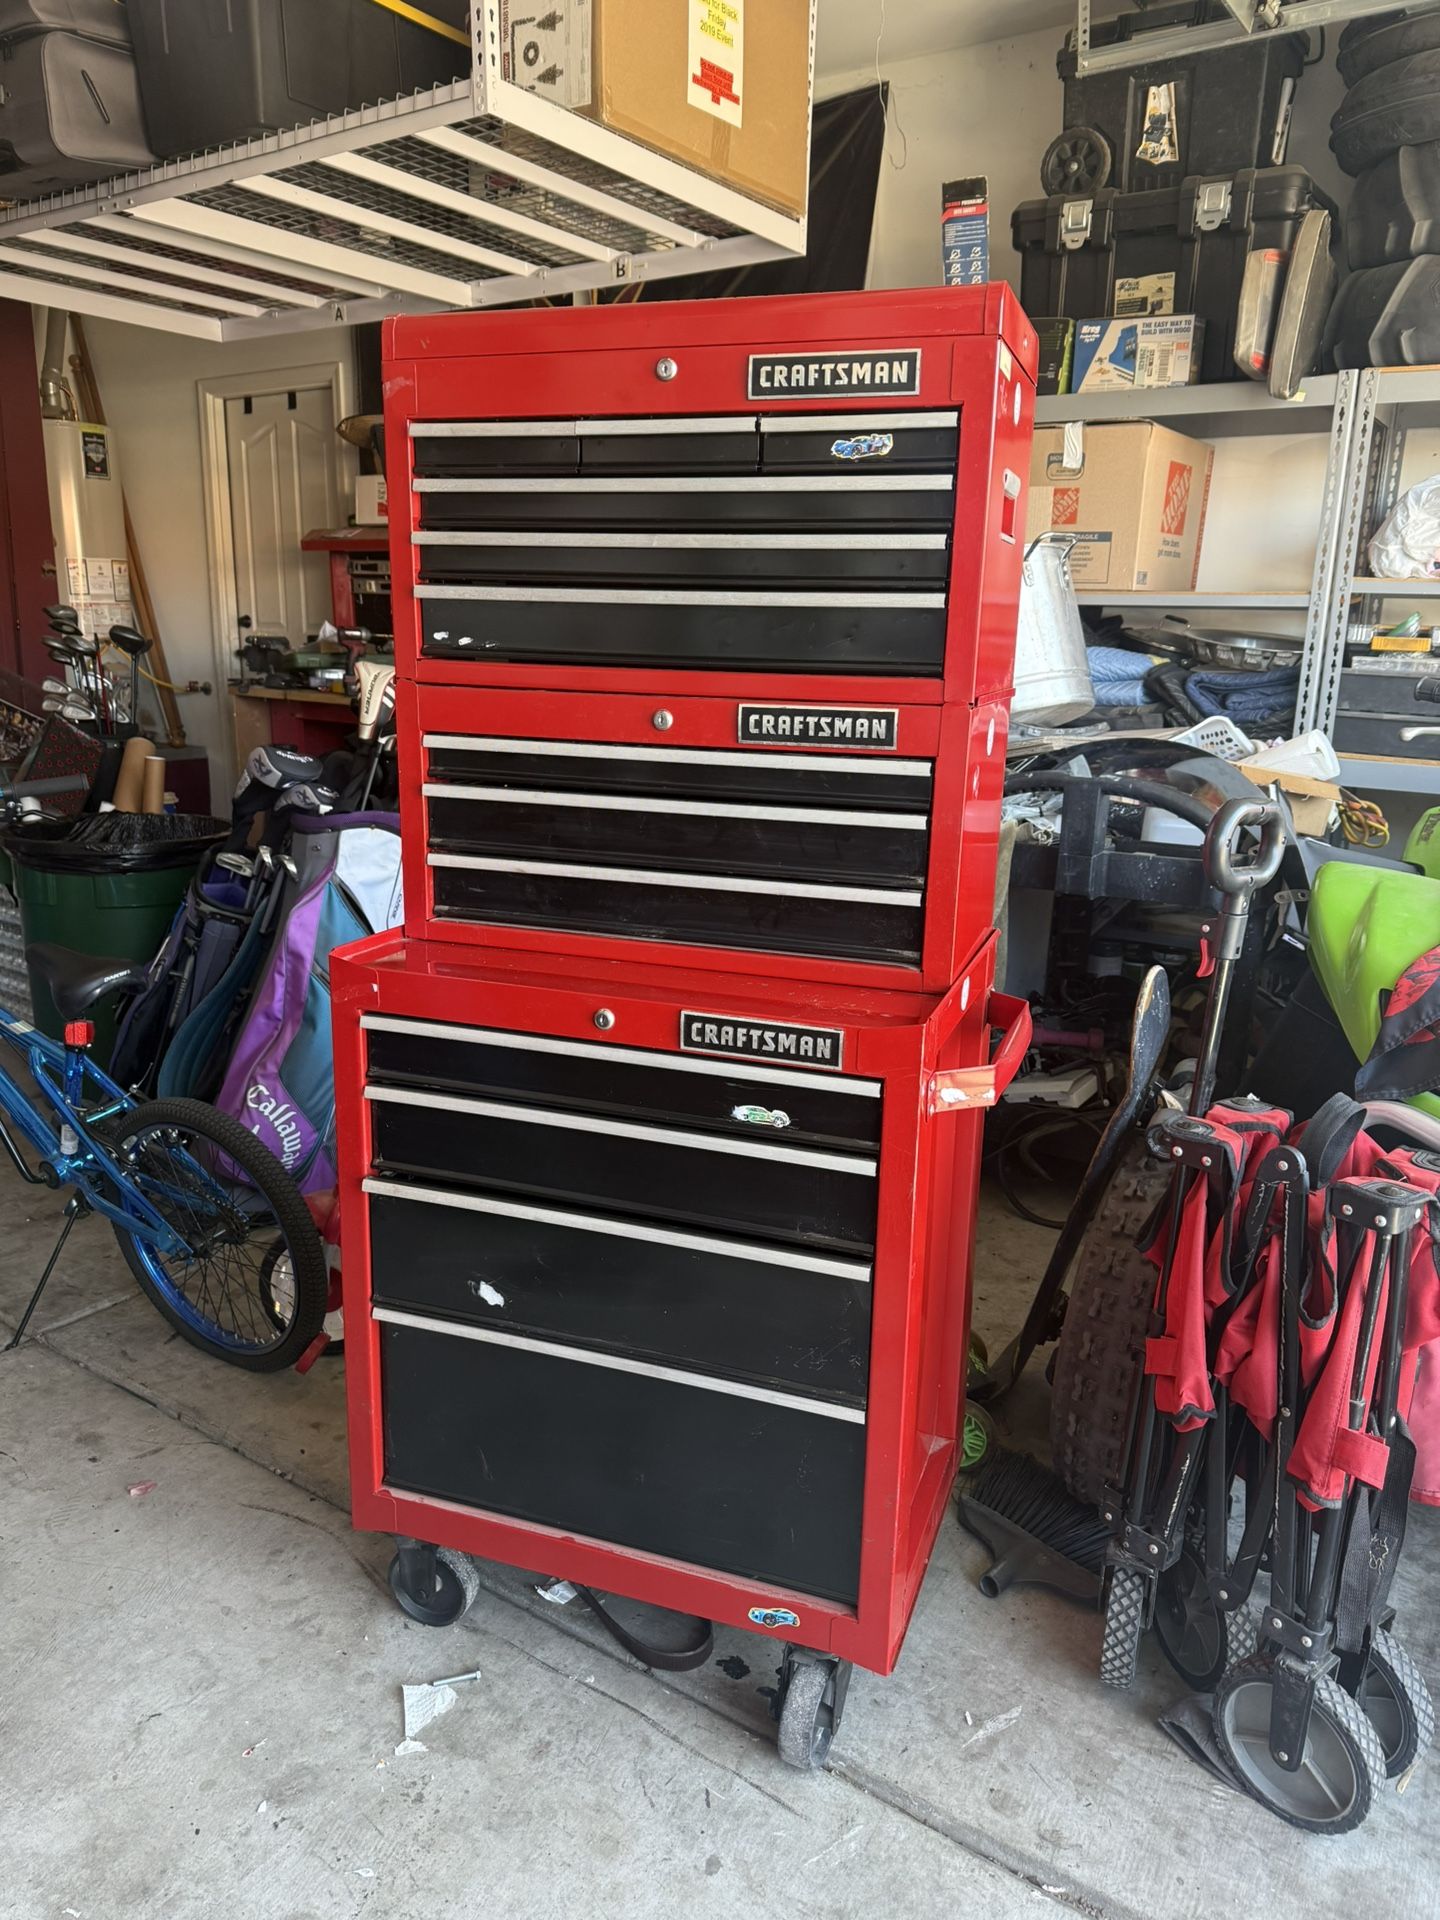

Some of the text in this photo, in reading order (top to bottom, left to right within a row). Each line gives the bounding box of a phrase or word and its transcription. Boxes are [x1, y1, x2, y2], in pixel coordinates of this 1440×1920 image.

[708, 9, 727, 31] Friday
[721, 3, 738, 20] Black
[700, 20, 734, 47] 2019 Event
[335, 306, 344, 321] A
[1141, 328, 1157, 336] BUILD
[1158, 327, 1173, 335] WITH
[759, 360, 908, 388] CRAFTSMAN
[749, 713, 886, 740] CRAFTSMAN
[691, 1022, 832, 1059] CRAFTSMAN
